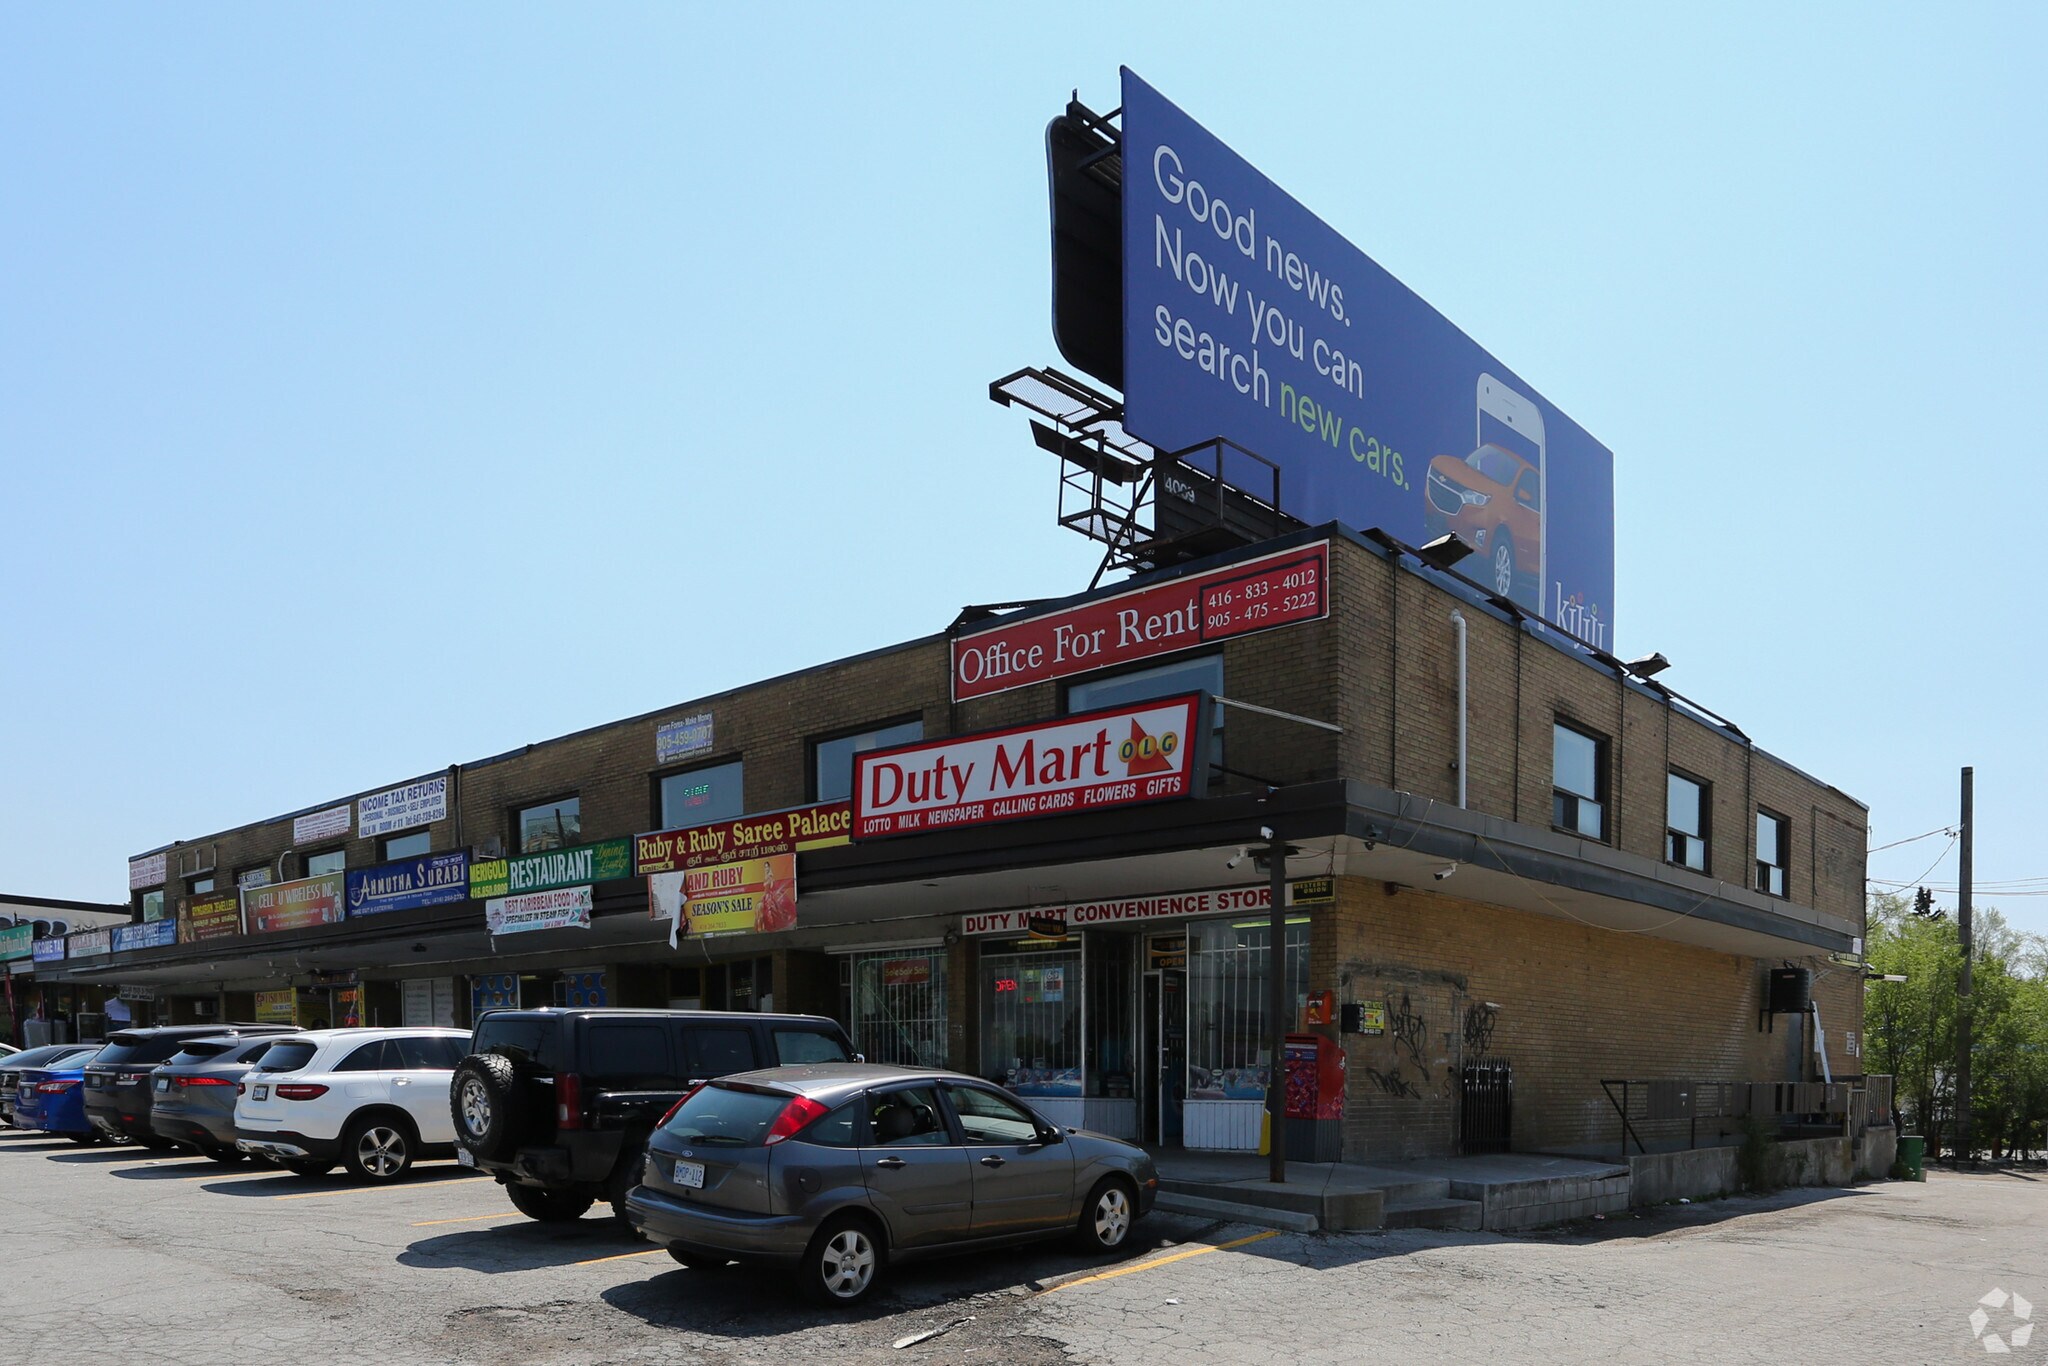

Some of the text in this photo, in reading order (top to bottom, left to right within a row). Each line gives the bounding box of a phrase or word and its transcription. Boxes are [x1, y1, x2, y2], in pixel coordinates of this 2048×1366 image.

[1154, 145, 1351, 328] Good news.
[1156, 213, 1363, 399] Now you can
[1155, 304, 1410, 491] search new cars.
[1208, 590, 1232, 608] 416
[1245, 581, 1269, 600] 833
[1282, 569, 1316, 590] 4012
[1208, 612, 1231, 630] 905
[1244, 603, 1268, 621] 475
[1283, 591, 1317, 612] 5222
[959, 598, 1200, 685] Office For Rent
[871, 727, 1112, 809] Duty Mart
[360, 778, 446, 813] INCOME TAX RETURNS
[863, 776, 1181, 834] LOTTO MILK NEWSPAPER CALLING CARDS FLOWERS GIFTS
[638, 808, 851, 863] Ruby & Ruby Saree Palace
[416, 864, 465, 888] SURABI
[469, 859, 508, 883] MERIGOLD
[509, 849, 593, 890] RESTAURANT
[687, 866, 744, 891] AND RUBY
[258, 892, 275, 908] CELL
[285, 884, 321, 904] WIRELESS
[322, 881, 335, 898] INC
[520, 893, 553, 912] CARIBBEAN
[554, 891, 571, 907] FOOD
[691, 897, 753, 917] SEASON'S SALE
[1303, 886, 1327, 894] UNION
[557, 907, 570, 918] FISH
[966, 914, 1011, 933] DUTY
[1074, 895, 1210, 922] CONVENIENCE
[1217, 888, 1272, 910] STOR
[33, 939, 53, 955] INCOME
[1159, 957, 1185, 968] OPEN
[995, 979, 1018, 993] OPEN
